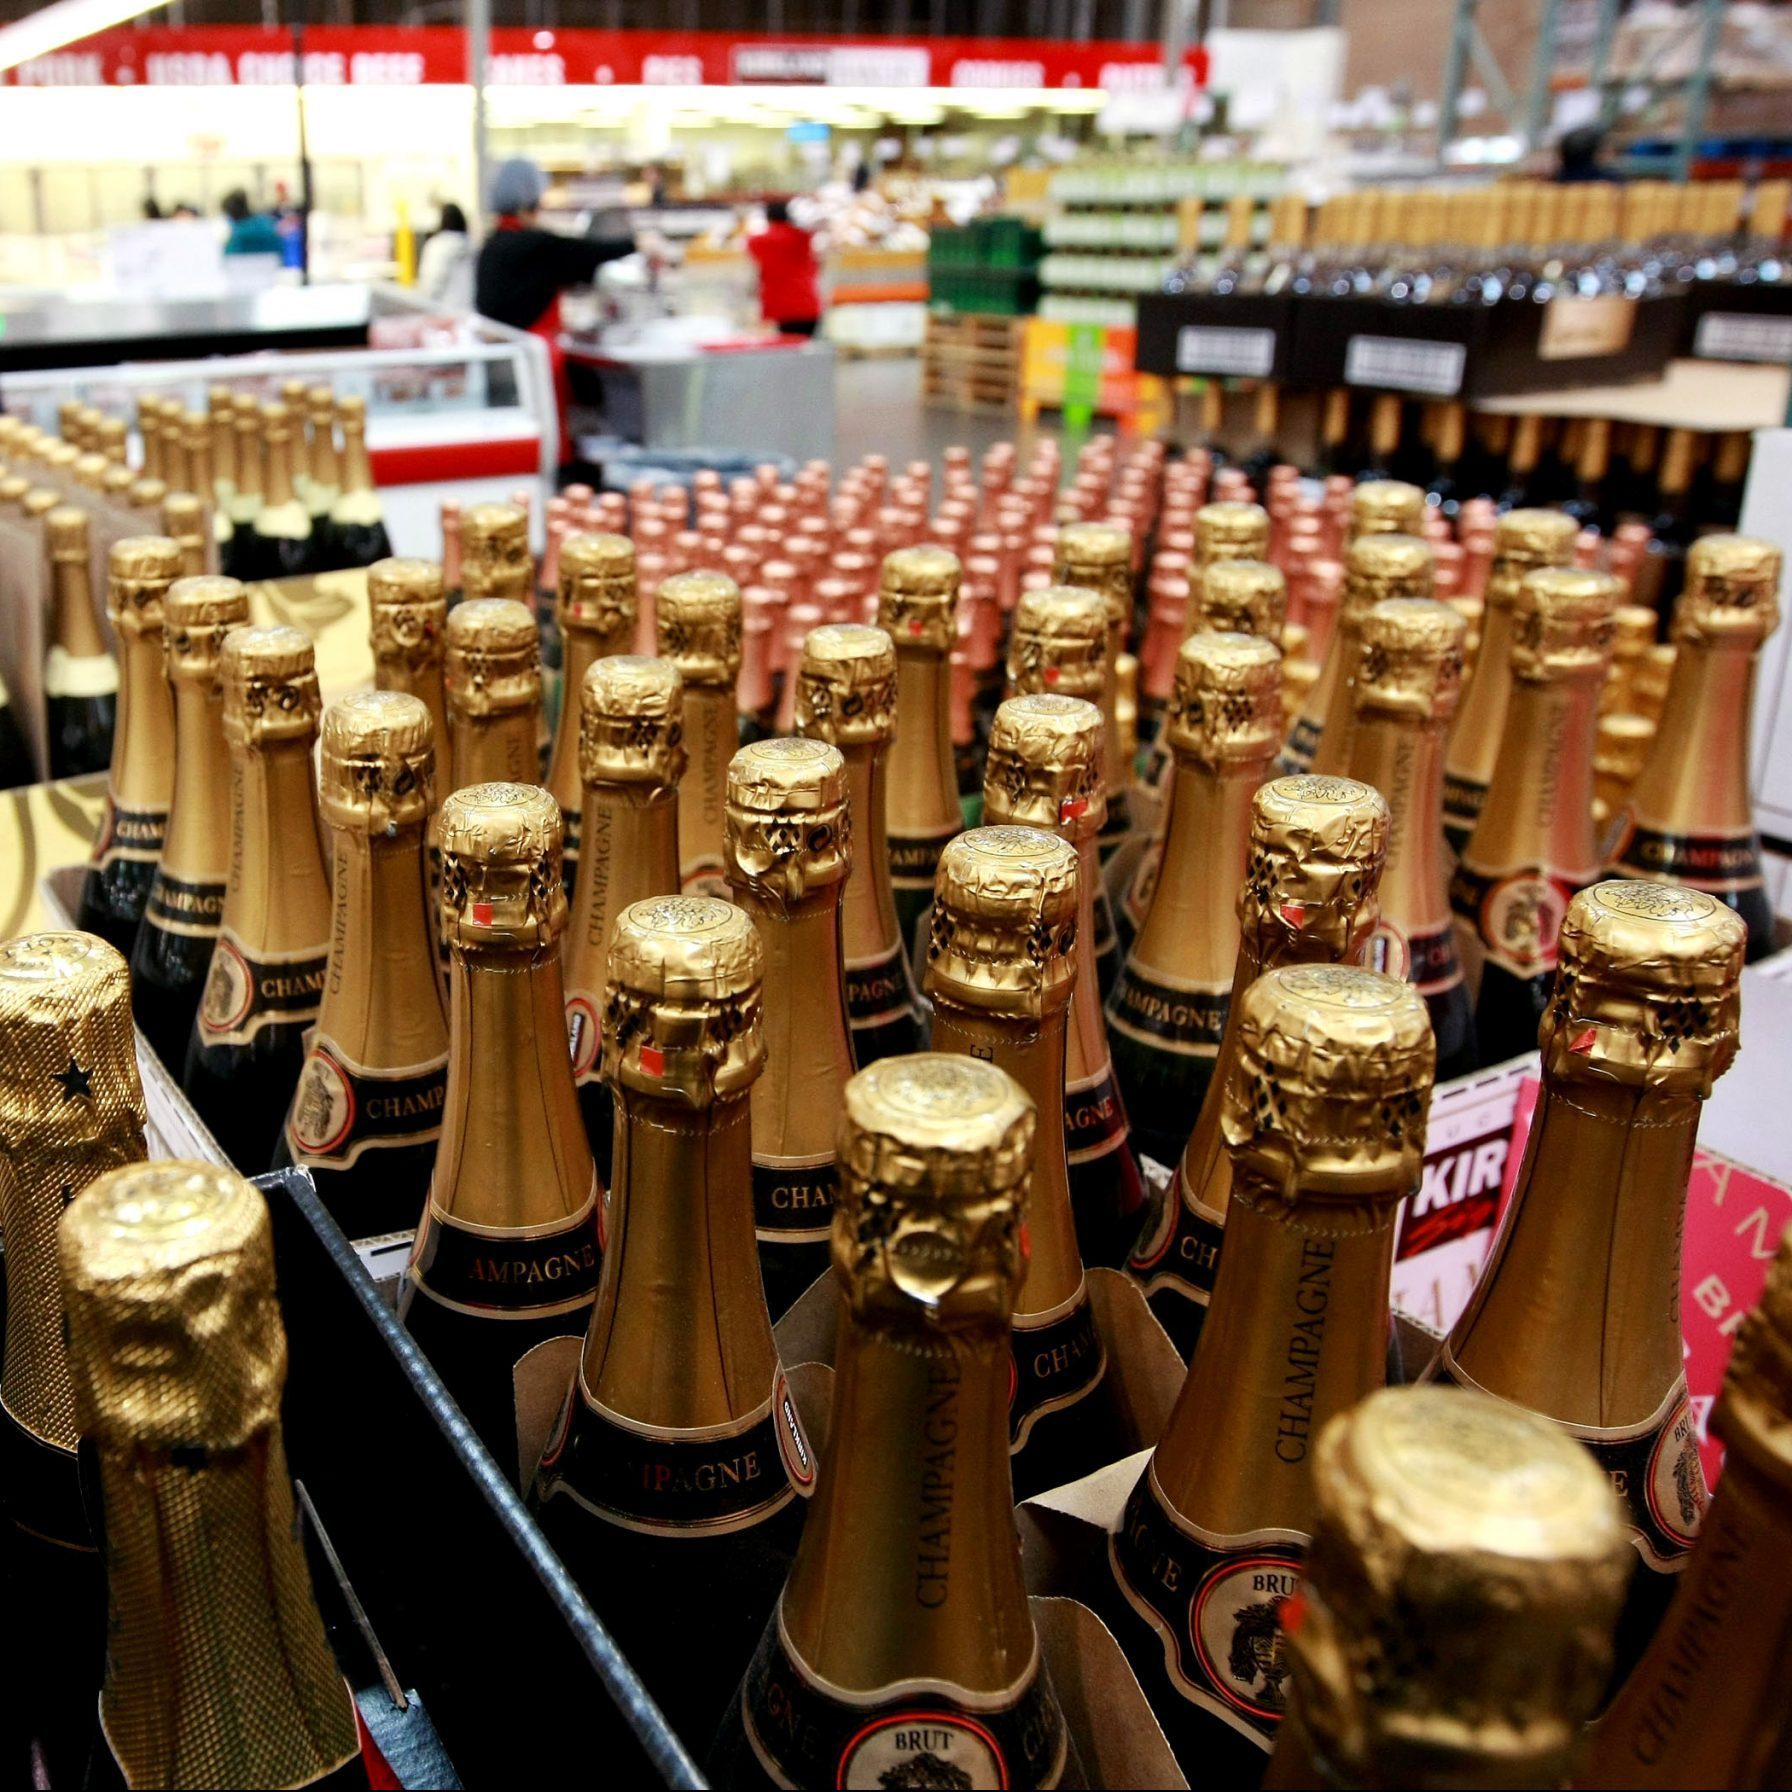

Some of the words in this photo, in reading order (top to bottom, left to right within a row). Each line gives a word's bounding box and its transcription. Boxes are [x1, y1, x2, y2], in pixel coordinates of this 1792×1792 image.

[231, 768, 244, 893] CHAMPAGNE
[590, 806, 613, 946] CHAMPAGNE
[330, 853, 349, 995] CHAMPAGNE
[366, 1086, 444, 1119] CHAMP
[1411, 1138, 1510, 1218] KIR
[1275, 1239, 1335, 1464] CHAMPAGNE
[642, 1451, 762, 1493] PAGNE
[915, 1360, 961, 1610] CHAMPAGNE
[894, 1730, 954, 1751] BRUT
